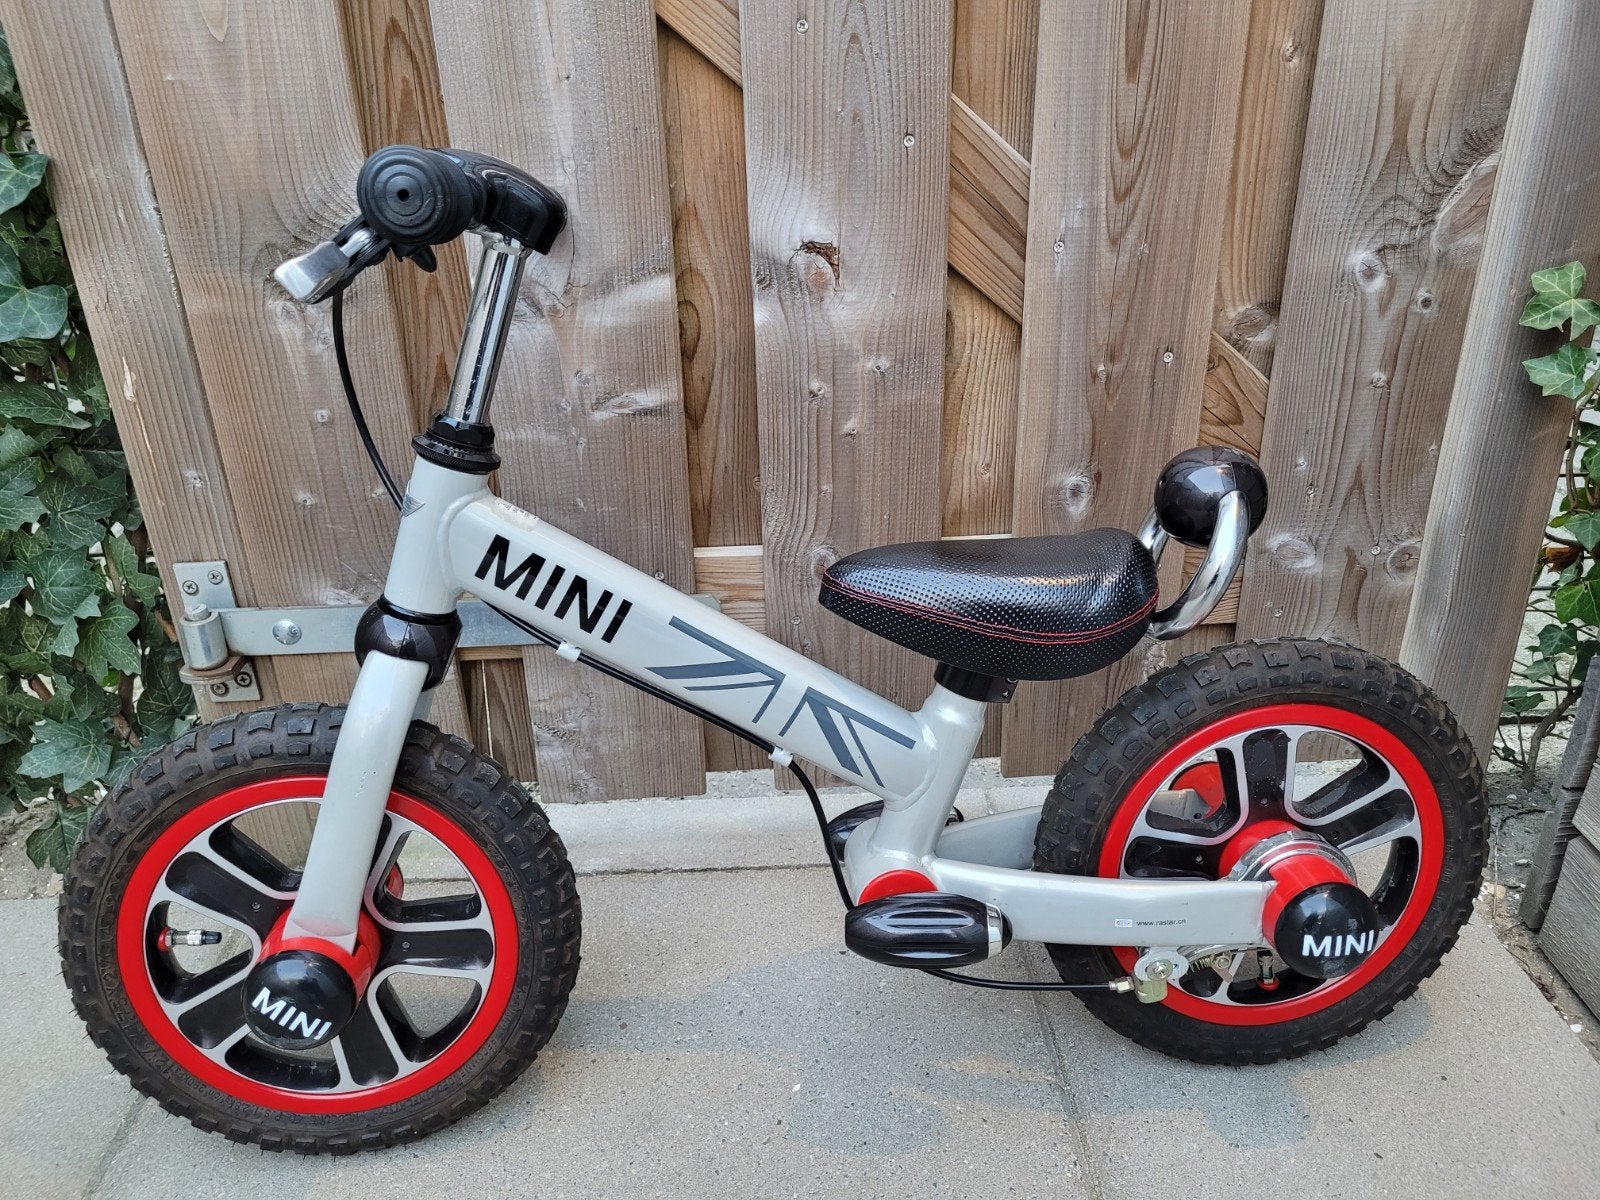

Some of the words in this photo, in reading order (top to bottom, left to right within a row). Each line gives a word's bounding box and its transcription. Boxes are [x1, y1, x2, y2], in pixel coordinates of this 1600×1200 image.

[474, 533, 633, 644] MINI
[1136, 918, 1187, 927] www.rastar.cn
[1302, 929, 1375, 957] MINI
[251, 986, 332, 1040] MINI
